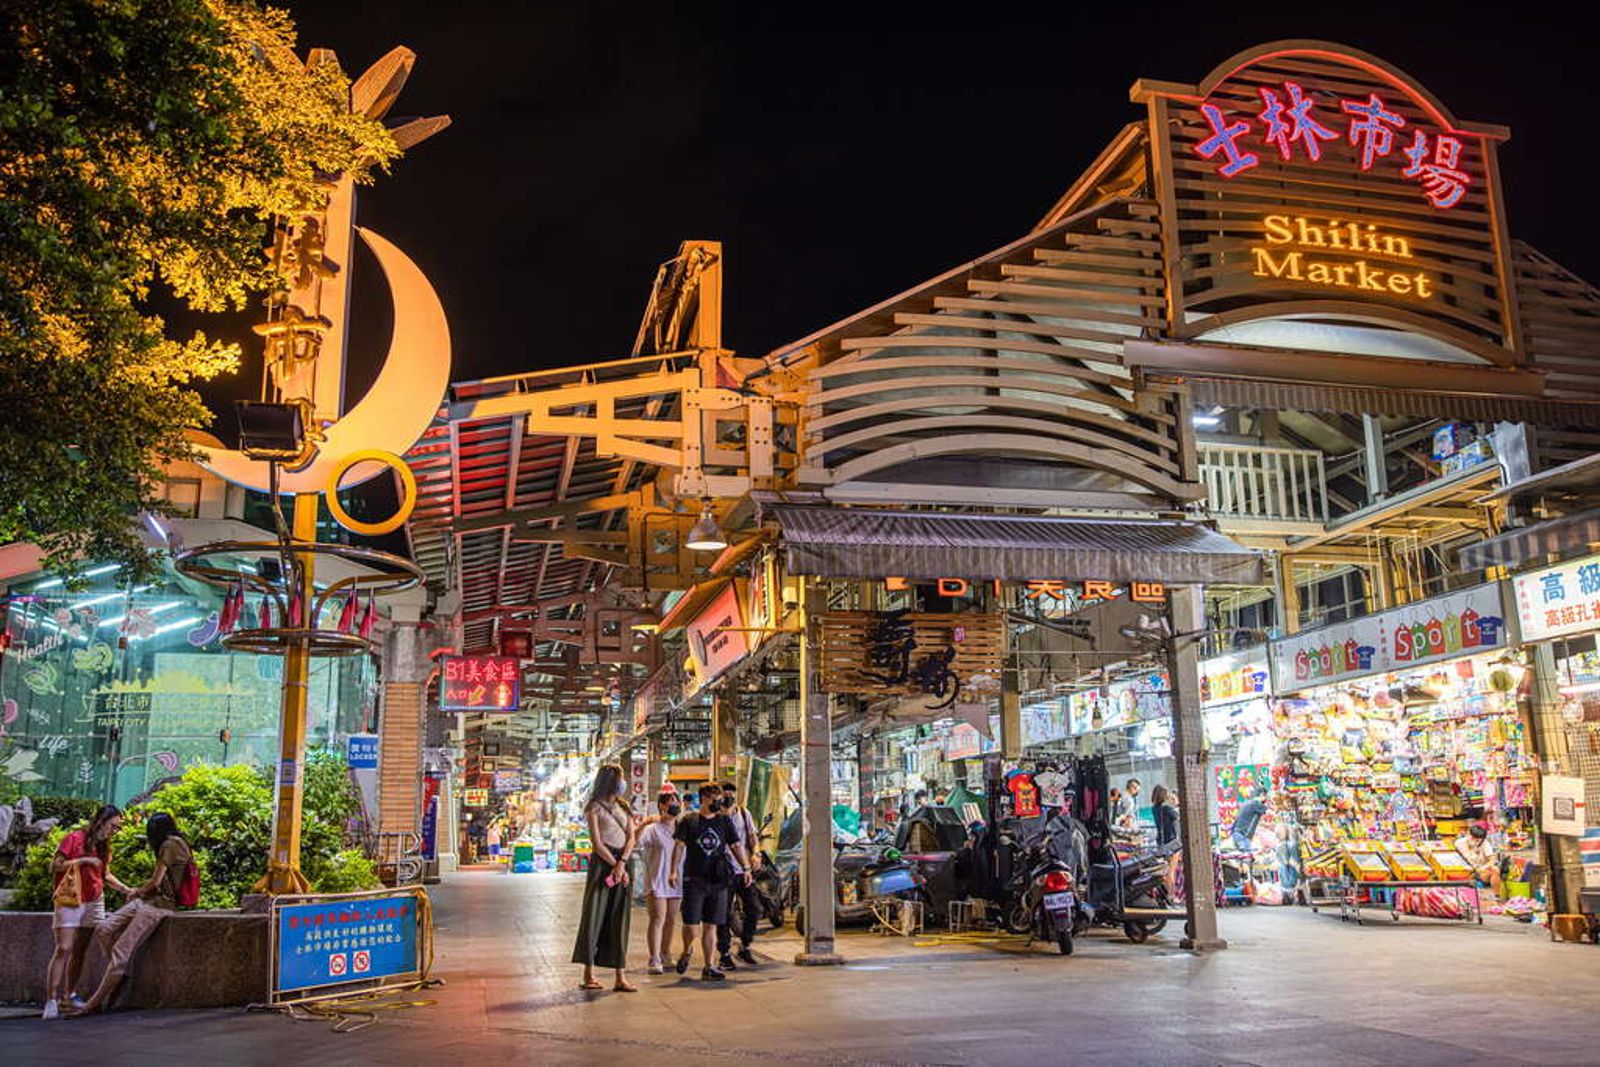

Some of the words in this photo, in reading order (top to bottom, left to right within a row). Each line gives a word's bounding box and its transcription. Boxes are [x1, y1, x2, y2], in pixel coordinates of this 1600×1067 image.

[1195, 80, 1472, 208] 士林市場
[1263, 214, 1413, 258] Shilin
[1251, 247, 1433, 298] Market
[17, 633, 64, 663] Health
[1397, 617, 1476, 660] Sport
[1297, 643, 1356, 679] Sport
[39, 734, 75, 755] Life
